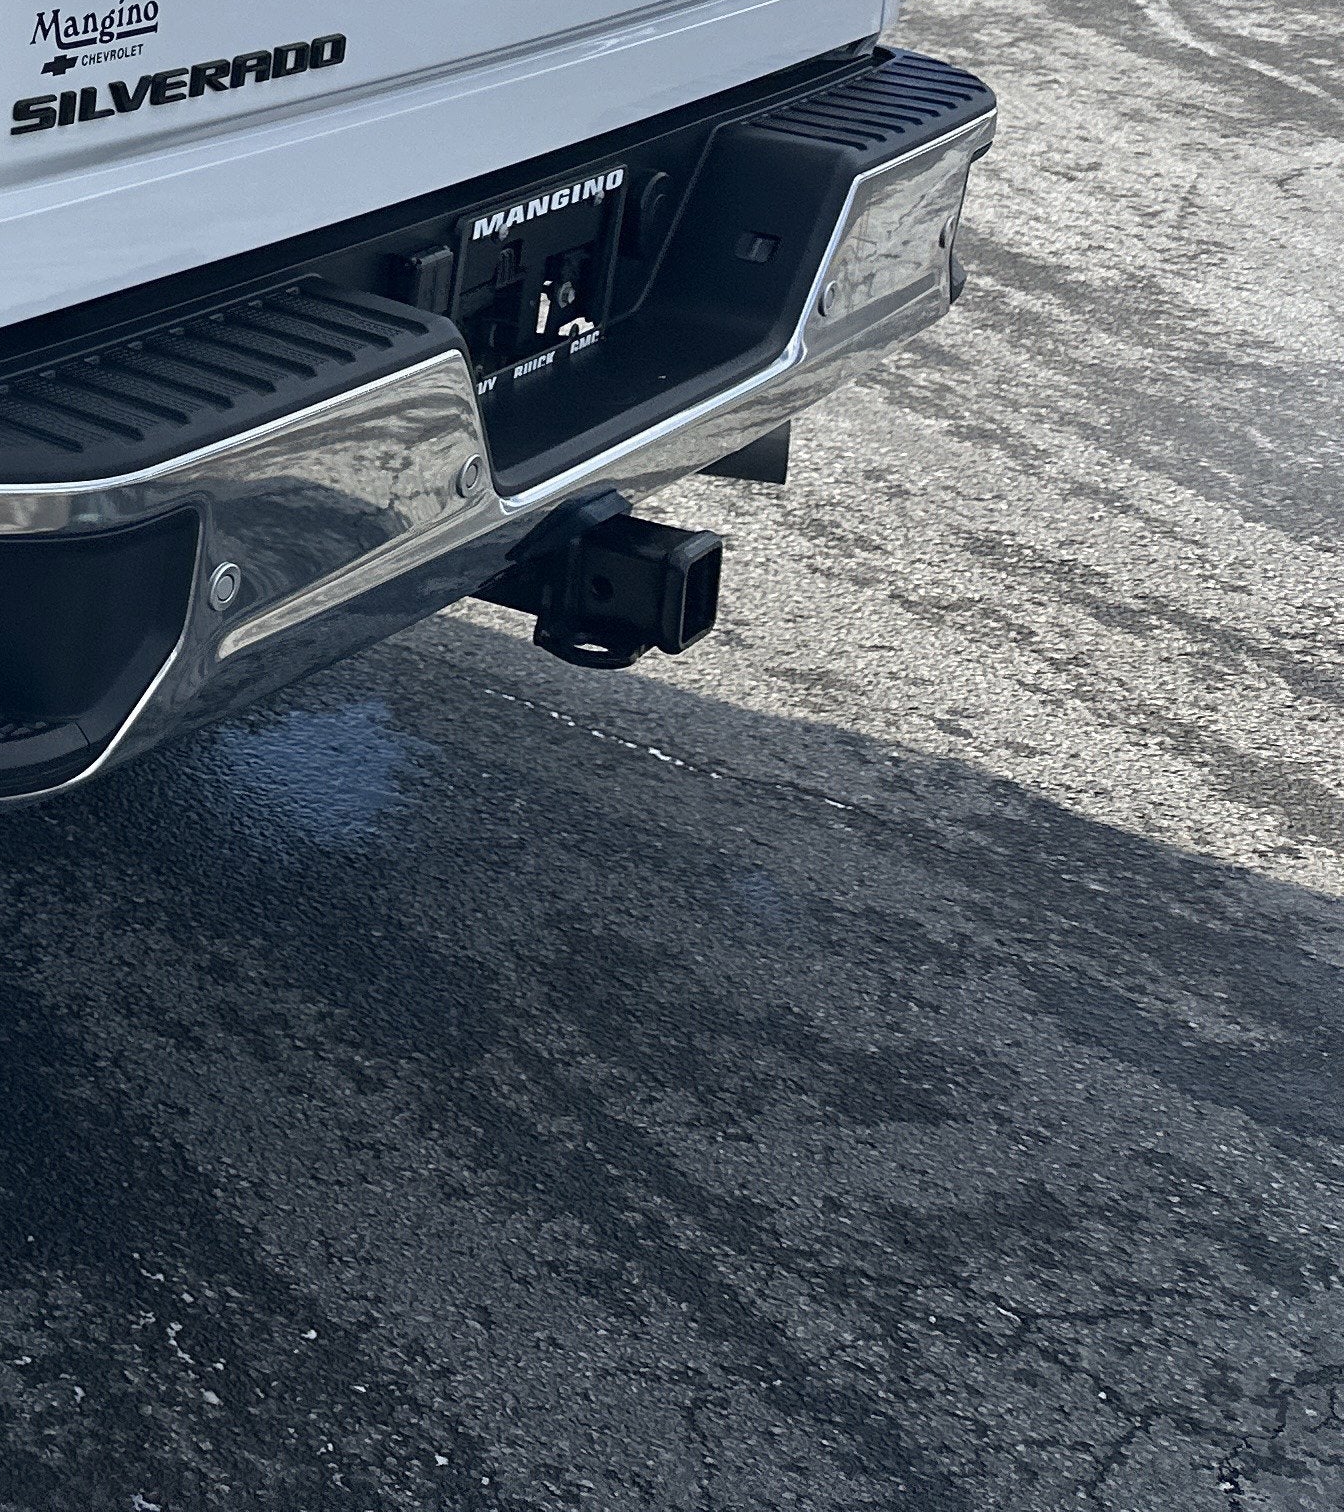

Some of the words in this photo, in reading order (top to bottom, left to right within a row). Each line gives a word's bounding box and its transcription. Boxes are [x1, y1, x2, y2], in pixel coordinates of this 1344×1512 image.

[10, 32, 348, 136] SILVERADO
[81, 44, 145, 67] CHEVROLET
[472, 168, 624, 241] MANGINO
